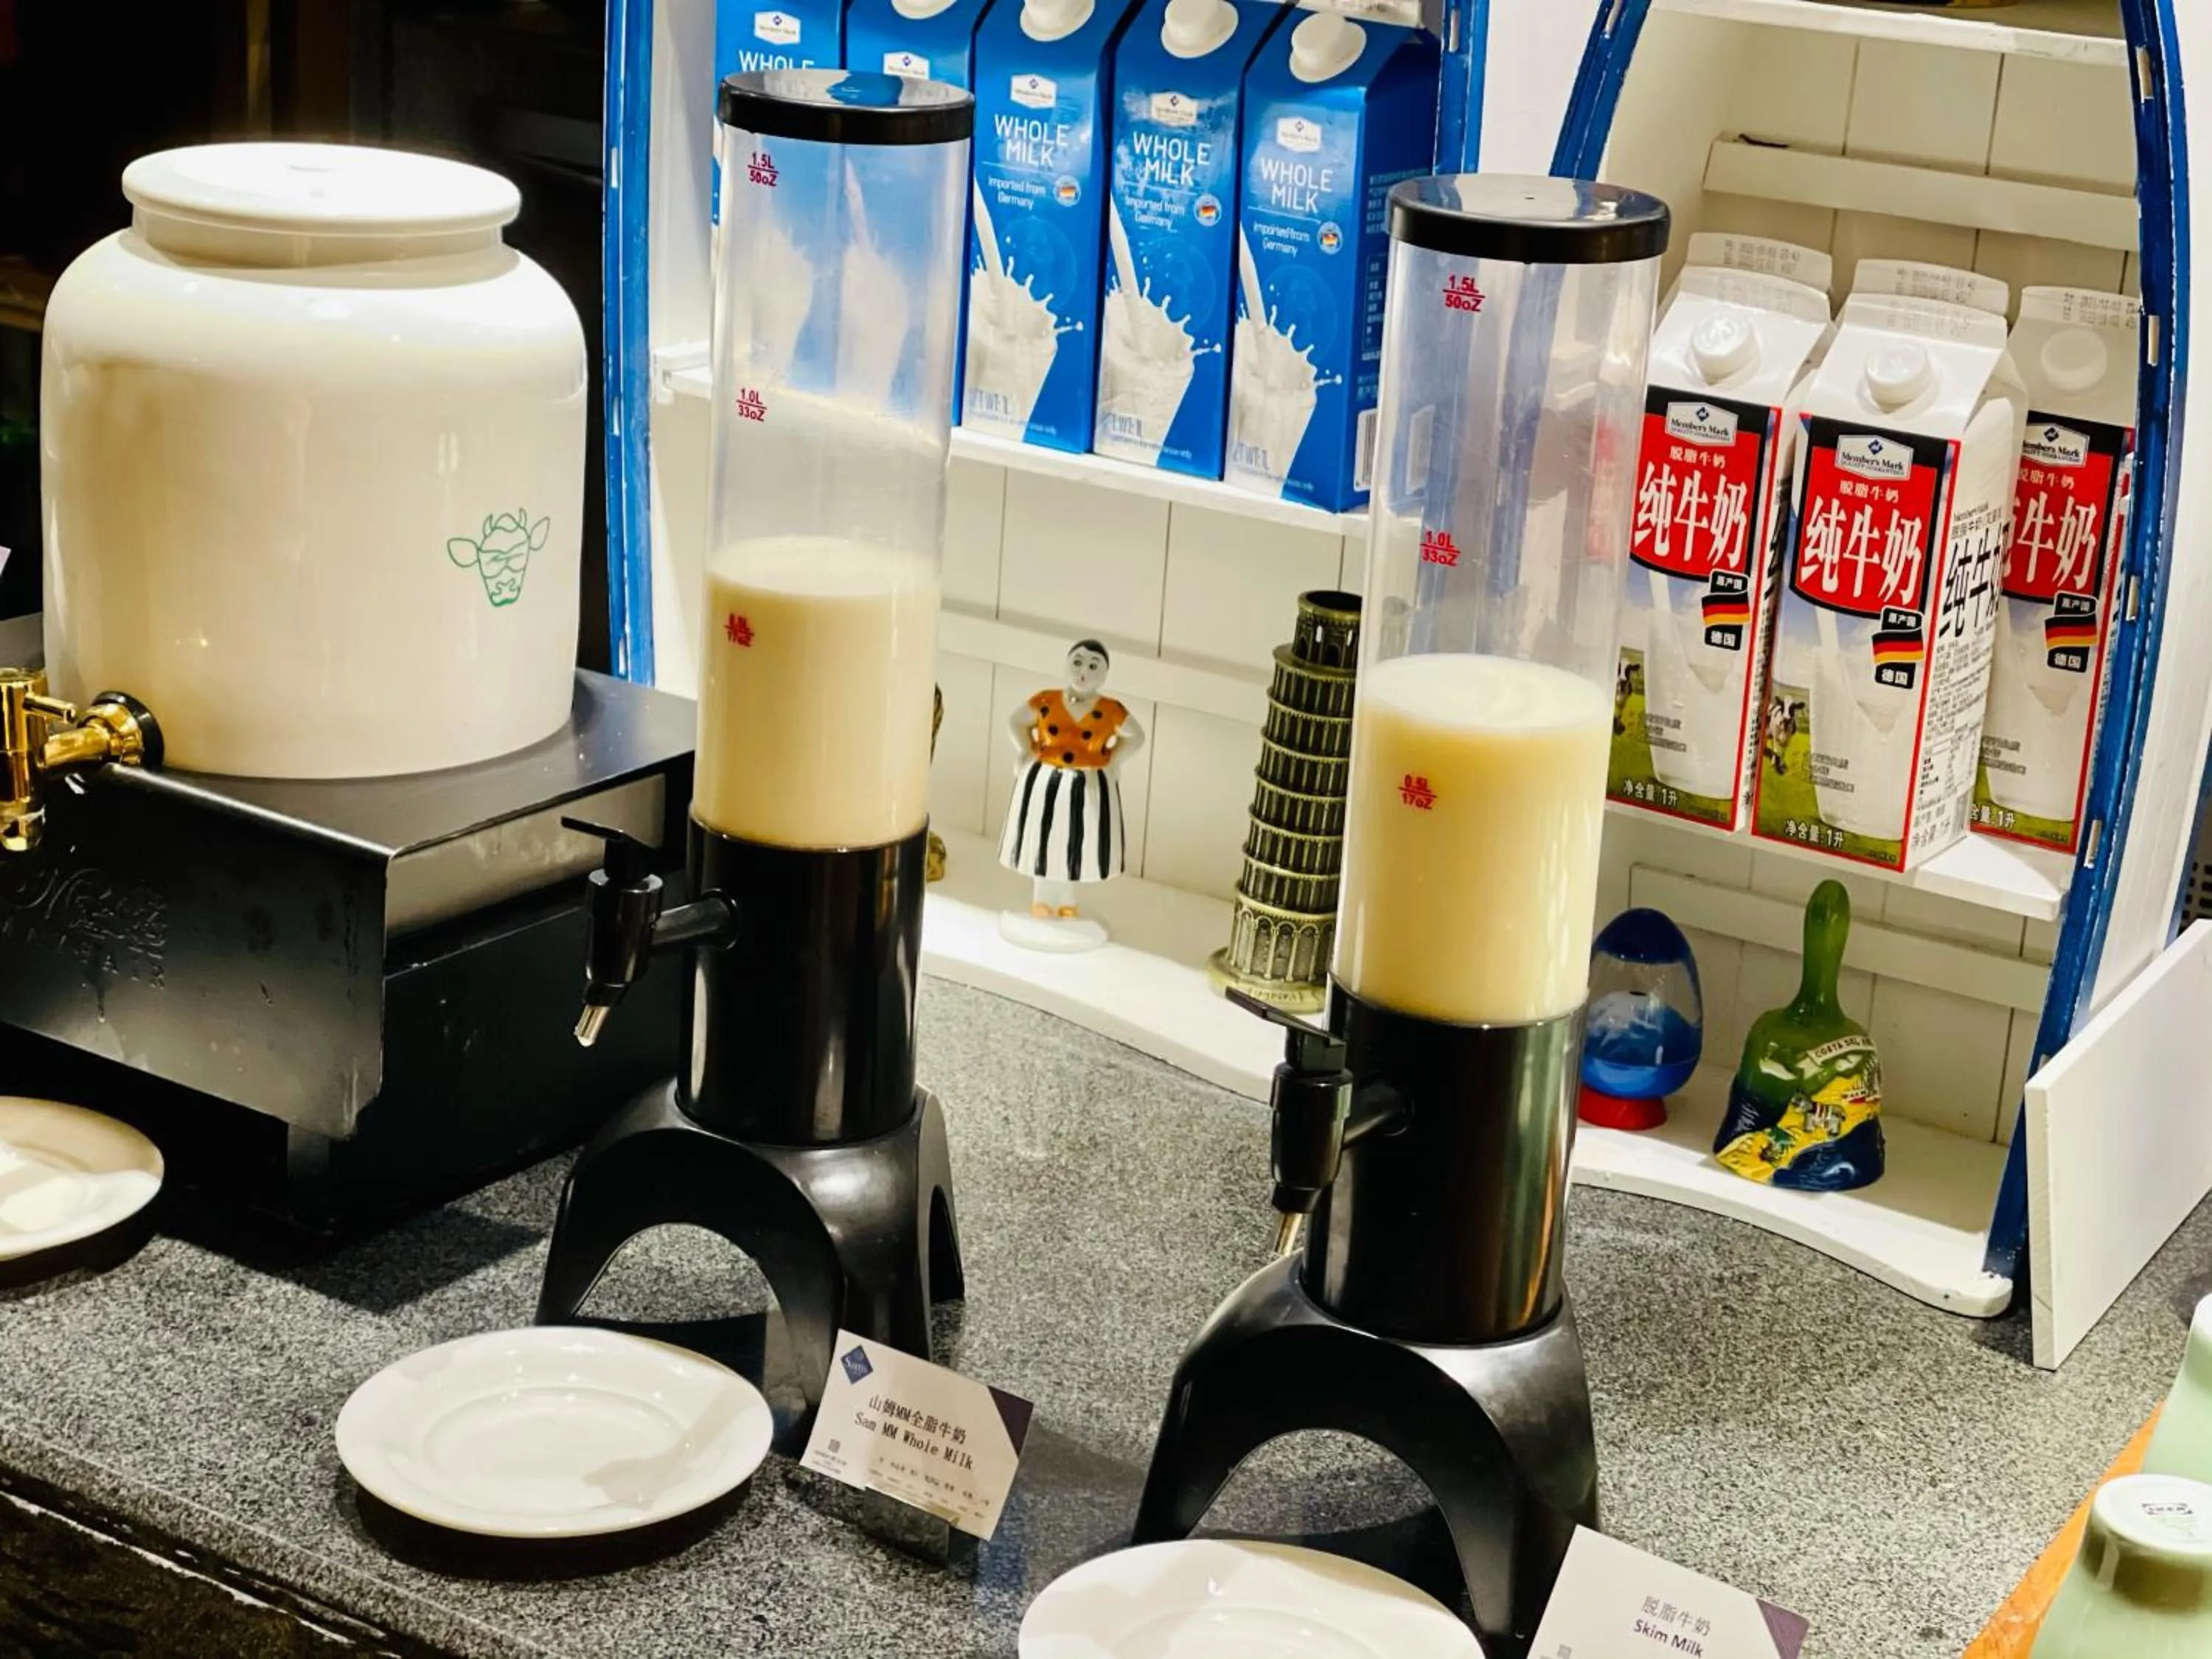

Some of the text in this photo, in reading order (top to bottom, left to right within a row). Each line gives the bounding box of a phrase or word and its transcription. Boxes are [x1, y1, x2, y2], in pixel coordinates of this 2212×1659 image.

[994, 114, 1070, 147] WHOLE
[1006, 138, 1054, 168] MILK
[1133, 131, 1211, 165] WHOLE
[751, 151, 775, 170] 1.5L
[1144, 157, 1194, 187] MILK
[989, 174, 1024, 193] Imported
[1260, 156, 1333, 192] WHOLE
[998, 191, 1034, 211] Germany
[1271, 184, 1318, 215] MILK
[1262, 237, 1298, 258] Germany
[1448, 274, 1479, 293] 1.5L
[740, 387, 763, 405] 1.0L
[1709, 425, 1729, 436] Mark
[1670, 445, 1726, 469] 脱脂牛奶
[2058, 446, 2080, 458] Mark
[1882, 459, 1903, 470] Mark
[1840, 479, 1899, 504] 脱脂牛奶
[1634, 460, 1747, 568] 纯牛奶
[1425, 530, 1455, 548] 1.0L
[1800, 495, 1922, 605] 纯牛奶
[2004, 490, 2097, 590] 牛奶
[1711, 630, 1736, 647] 德国
[2054, 653, 2081, 669] 德国
[1881, 668, 1908, 686] 德国
[855, 1411, 877, 1432] Sam
[902, 1429, 939, 1455] Whole
[943, 1446, 973, 1470] Milk
[1641, 1595, 1711, 1637] 脱脂牛奶
[1633, 1619, 1703, 1658] Skim Milk
